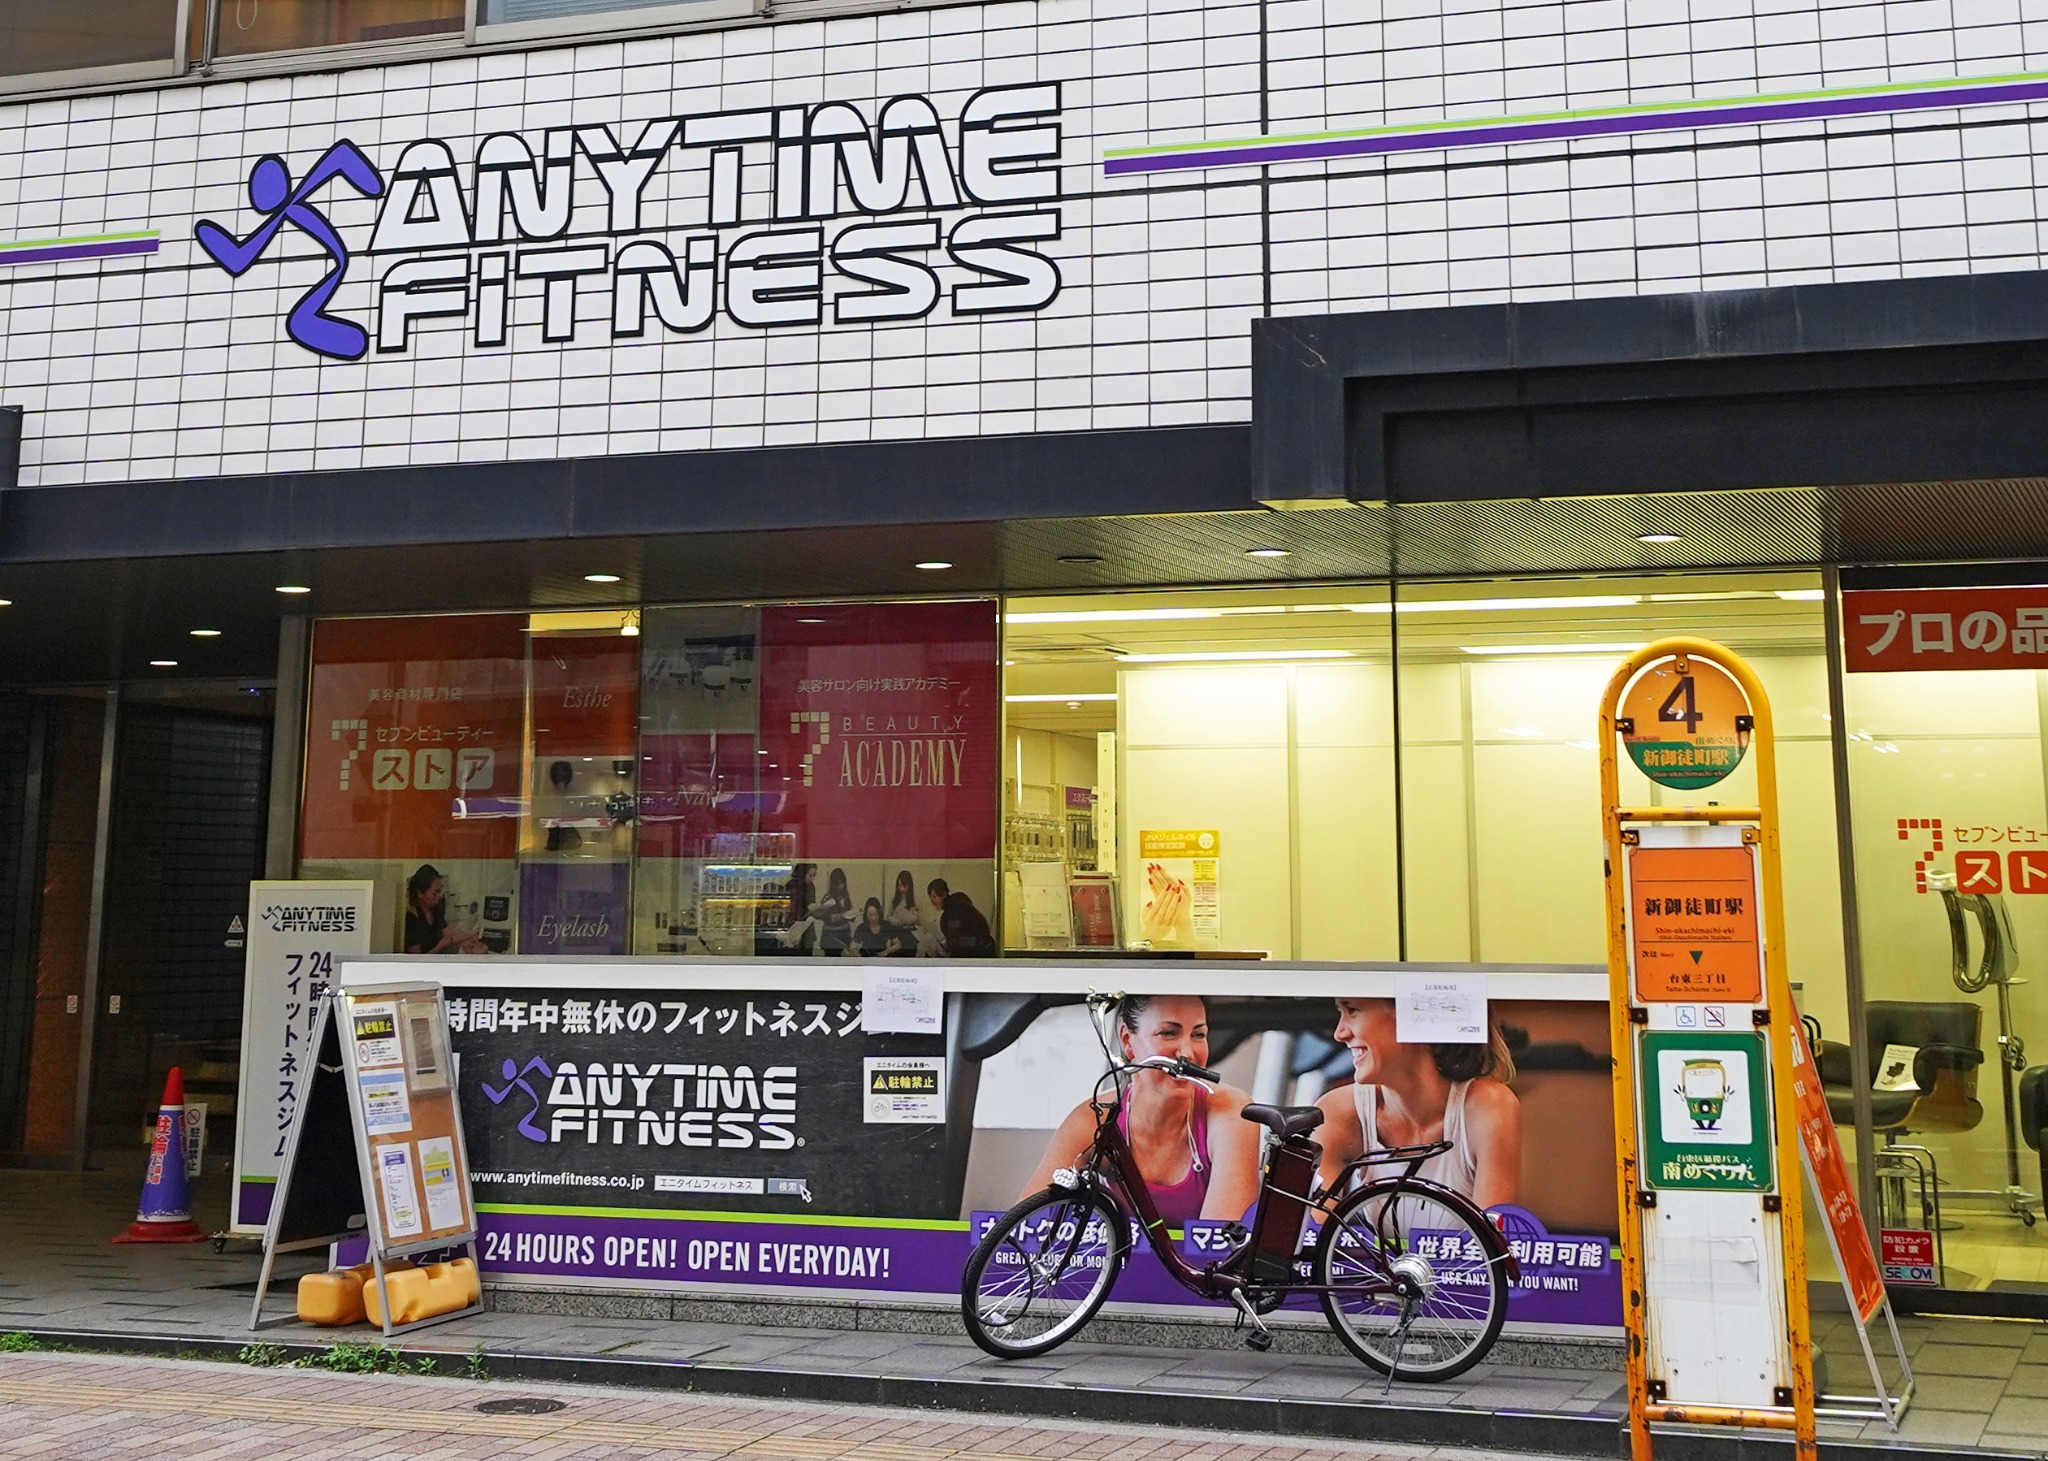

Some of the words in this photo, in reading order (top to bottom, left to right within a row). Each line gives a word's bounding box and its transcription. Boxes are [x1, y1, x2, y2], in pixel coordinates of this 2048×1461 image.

[371, 82, 1063, 252] ANYTIME
[376, 207, 1063, 355] FITNESS
[1859, 606, 2048, 656] プロの品
[798, 677, 961, 693] 美容サロン向け実践アカデミー
[562, 686, 612, 709] Esthe
[1658, 676, 1703, 734] 4
[843, 715, 964, 732] BEAUTY
[375, 725, 494, 742] セブンビューティー
[839, 739, 967, 787] ACADEMY
[1643, 749, 1730, 767] 新御徒町駅
[376, 753, 491, 785] ストア
[1961, 855, 2048, 889] スト
[281, 906, 356, 920] ANYTIME
[1644, 897, 1743, 916] 新御徒町駅
[282, 921, 356, 932] FITNESS
[537, 913, 610, 945] Eyelash
[1669, 973, 1726, 984] 台東三丁目
[547, 1062, 798, 1110] ANYTIME
[888, 1075, 935, 1090] 駐輪禁止
[470, 1170, 645, 1190] www.anytimefitness.co.jp
[659, 1178, 753, 1190] エニタイムフィットネス
[778, 1180, 798, 1193] 検索
[484, 1231, 512, 1261] 24
[516, 1232, 595, 1266] HOURS
[603, 1236, 677, 1269] OPEN!
[688, 1239, 750, 1272] OPEN
[758, 1242, 890, 1279] EVERYDAY!
[1417, 1235, 1603, 1268] 世界全利用可能
[1894, 1244, 1920, 1254] 設置
[1885, 1266, 1932, 1280] SECOM
[1543, 1276, 1579, 1292] WANT!
